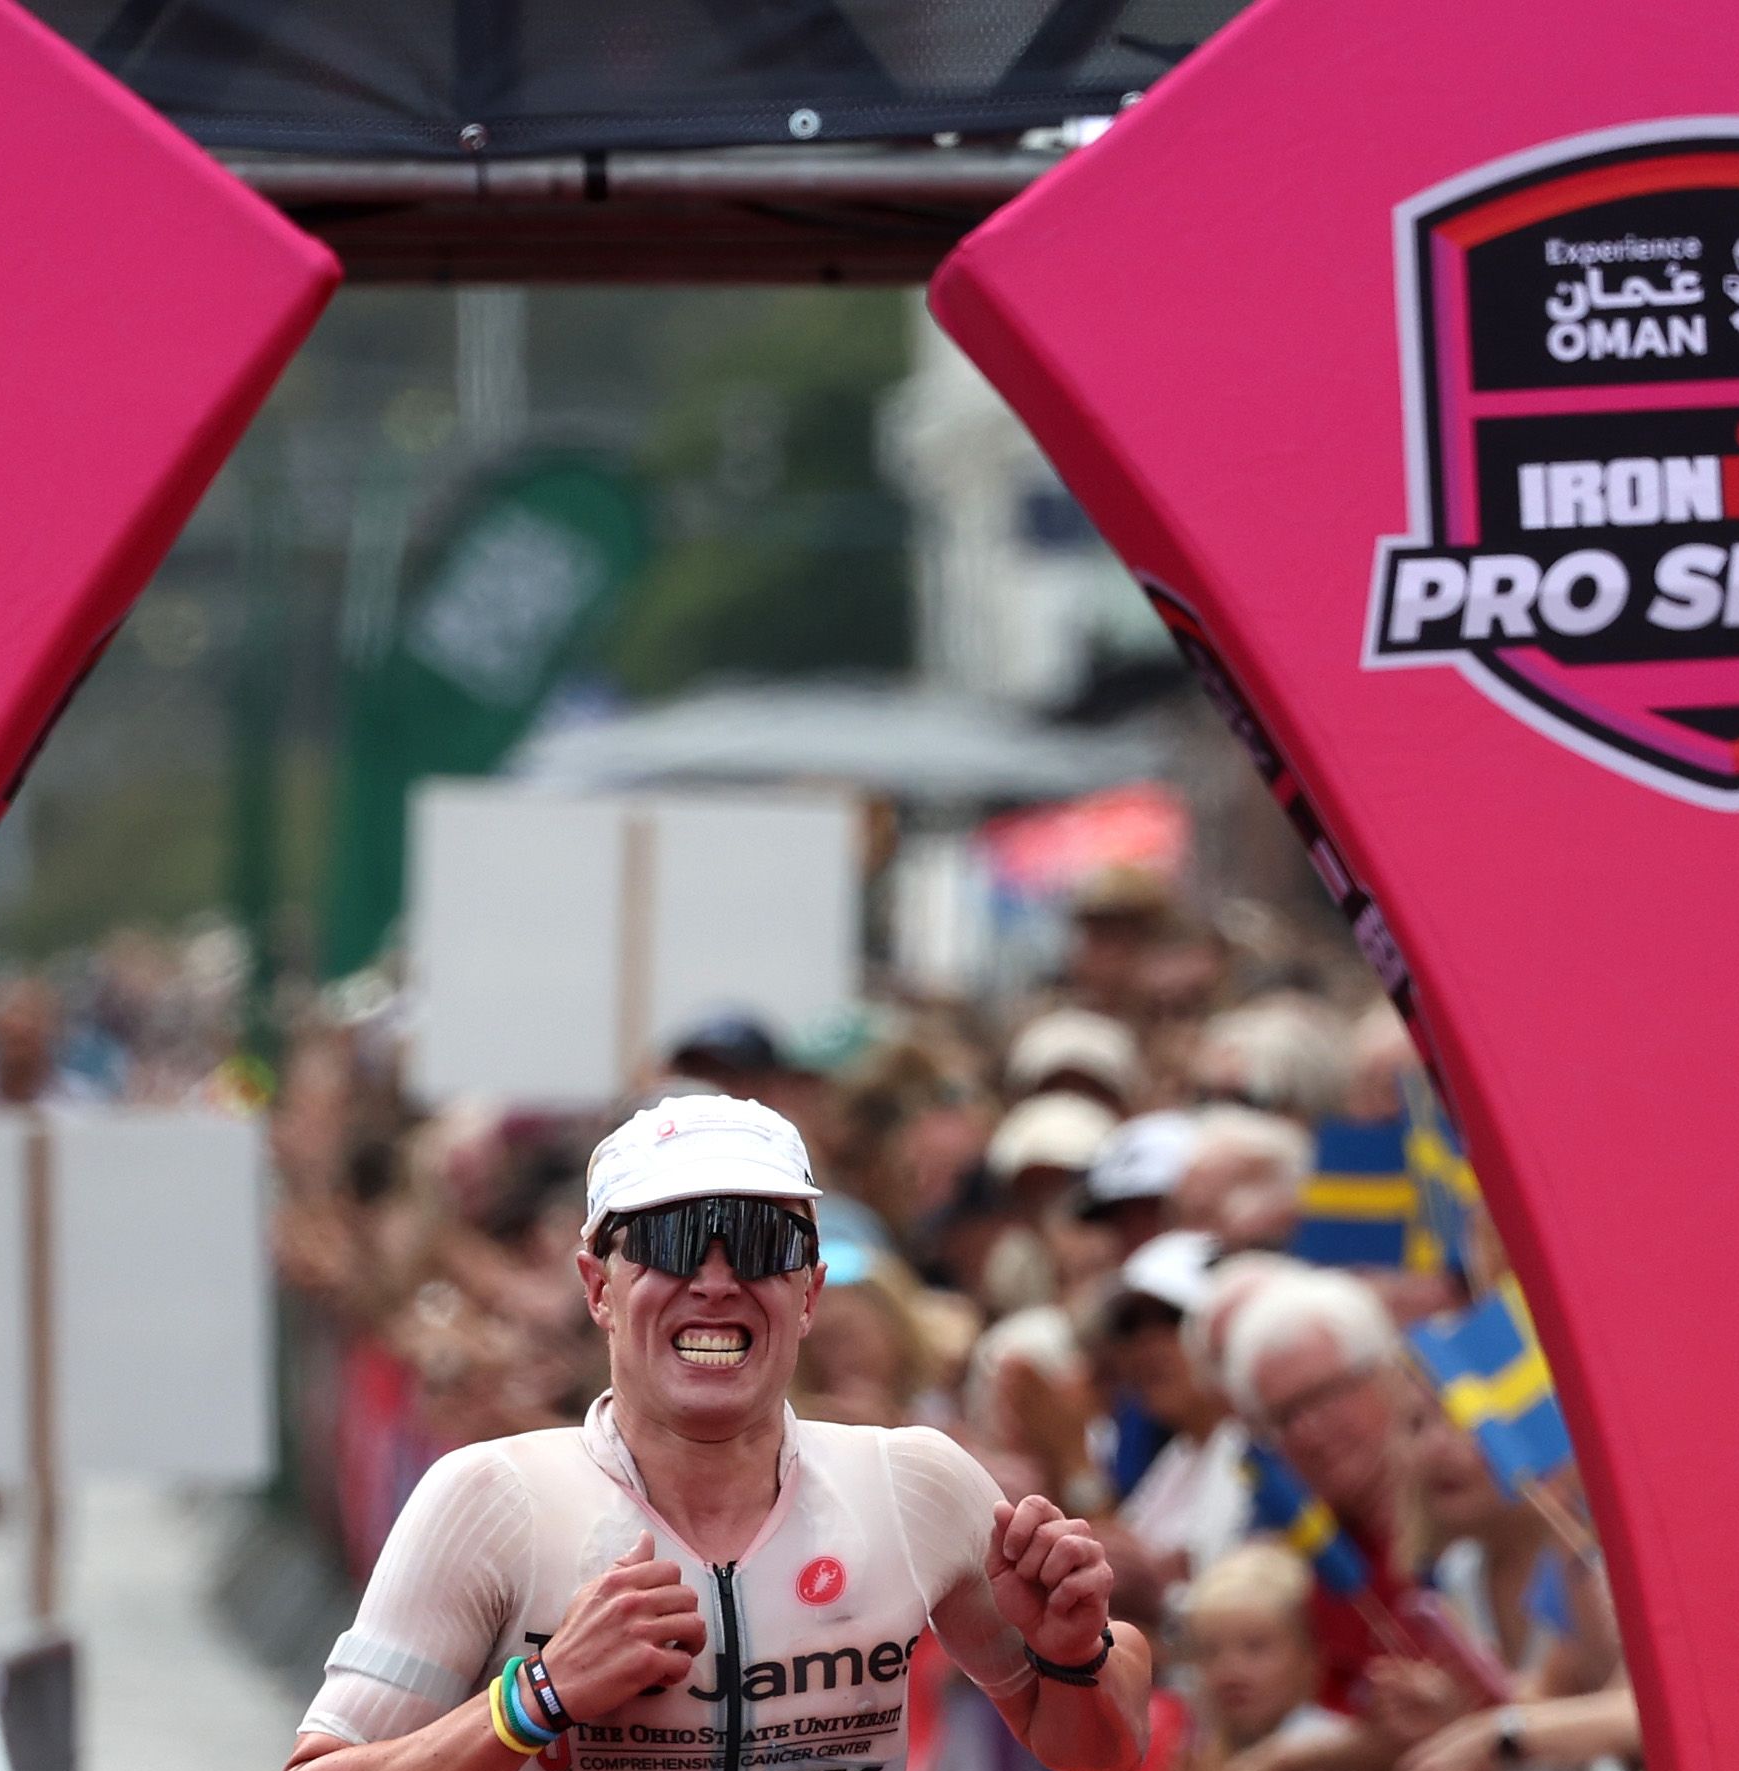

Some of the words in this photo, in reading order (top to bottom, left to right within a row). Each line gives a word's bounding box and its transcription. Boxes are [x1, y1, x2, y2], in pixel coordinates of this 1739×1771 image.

[1544, 231, 1703, 270] Experience
[1546, 314, 1708, 362] OMAN
[1388, 549, 1630, 644] PRO
[575, 1723, 623, 1742] THE
[629, 1725, 696, 1745] OHIO
[579, 1755, 727, 1771] COMPREHENSIVE
[740, 1748, 813, 1767] CANCER
[816, 1740, 872, 1758] CENTER
